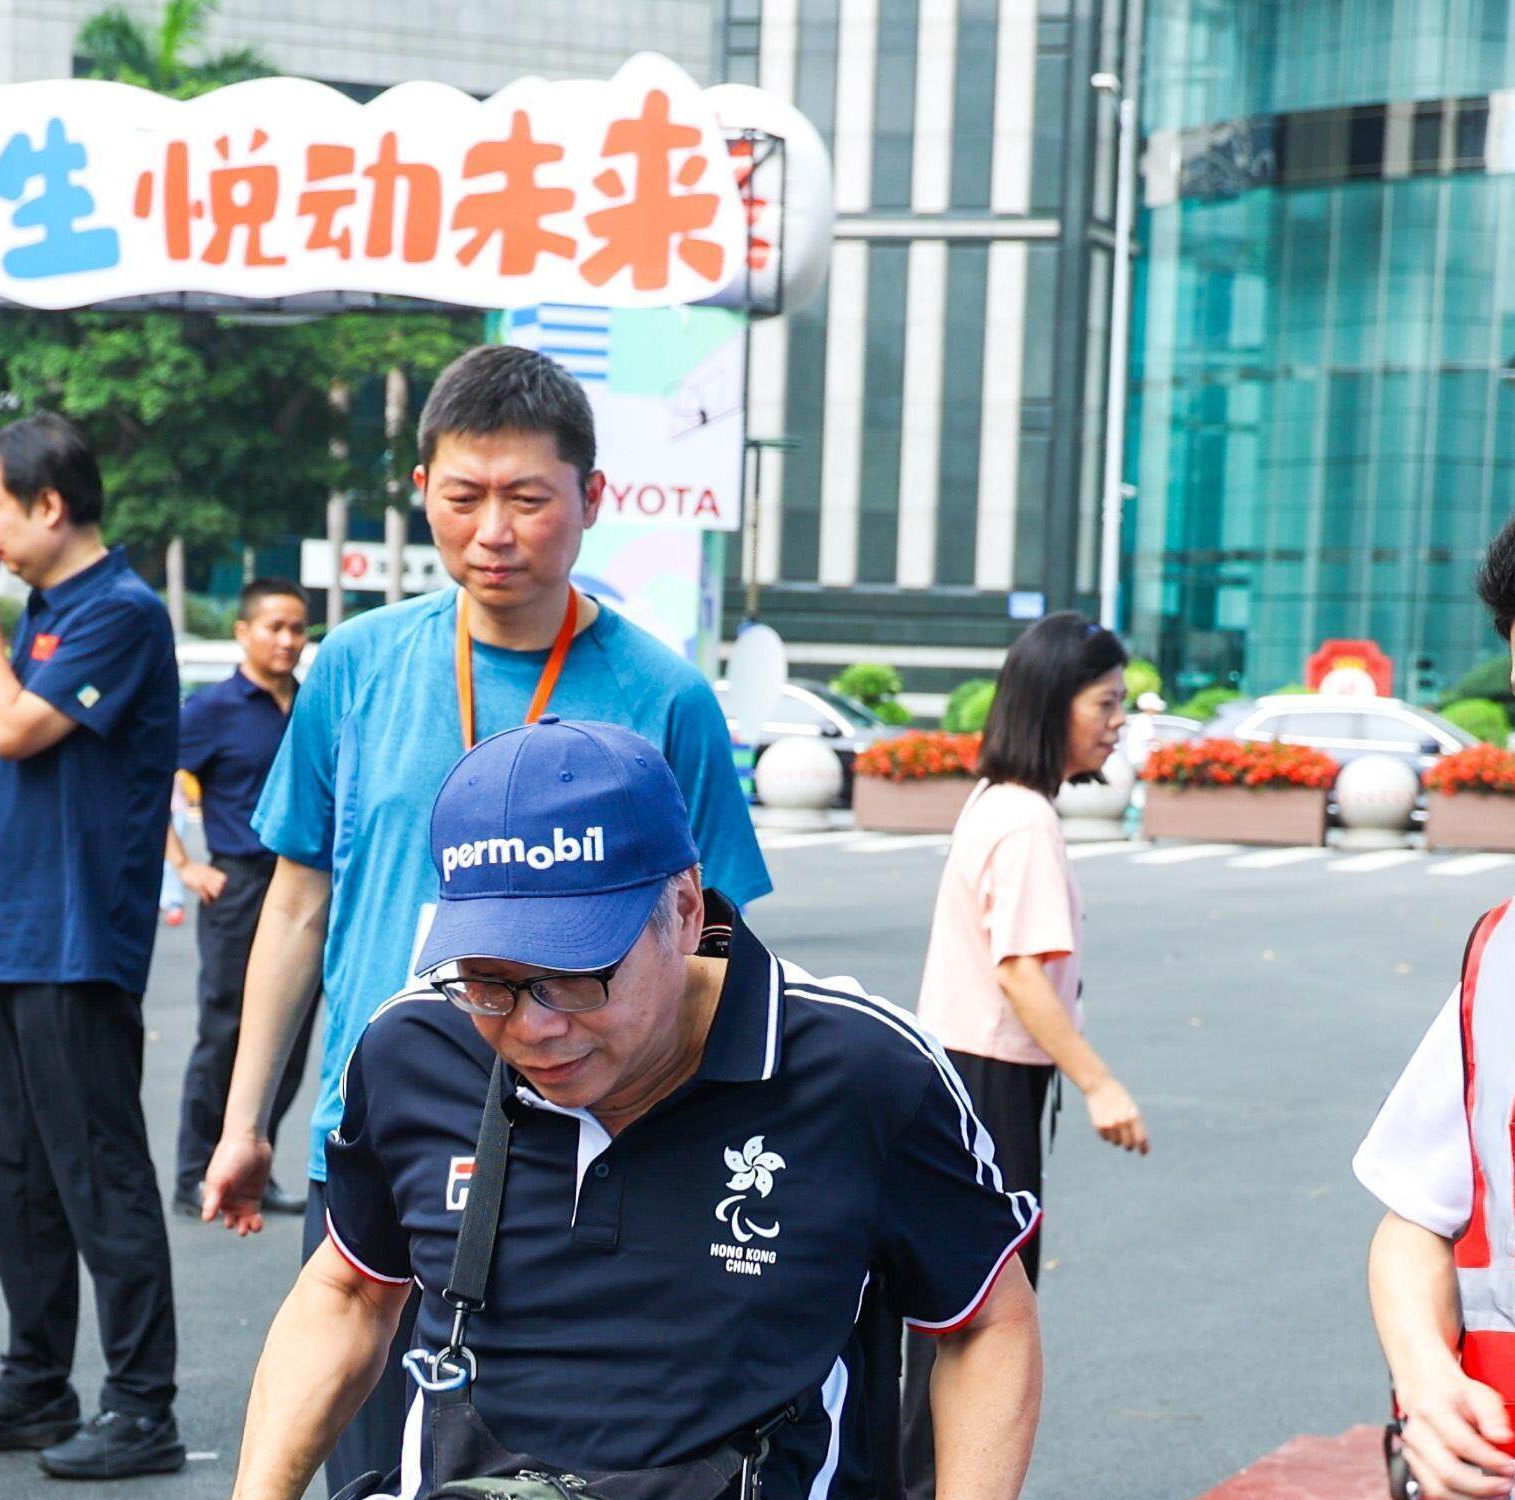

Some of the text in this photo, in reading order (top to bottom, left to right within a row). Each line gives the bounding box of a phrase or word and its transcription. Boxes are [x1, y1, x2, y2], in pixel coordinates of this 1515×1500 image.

[605, 484, 721, 518] YOTA
[442, 826, 605, 882] permobil
[710, 1243, 777, 1264] HONG KONG
[725, 1258, 762, 1276] CHINA
